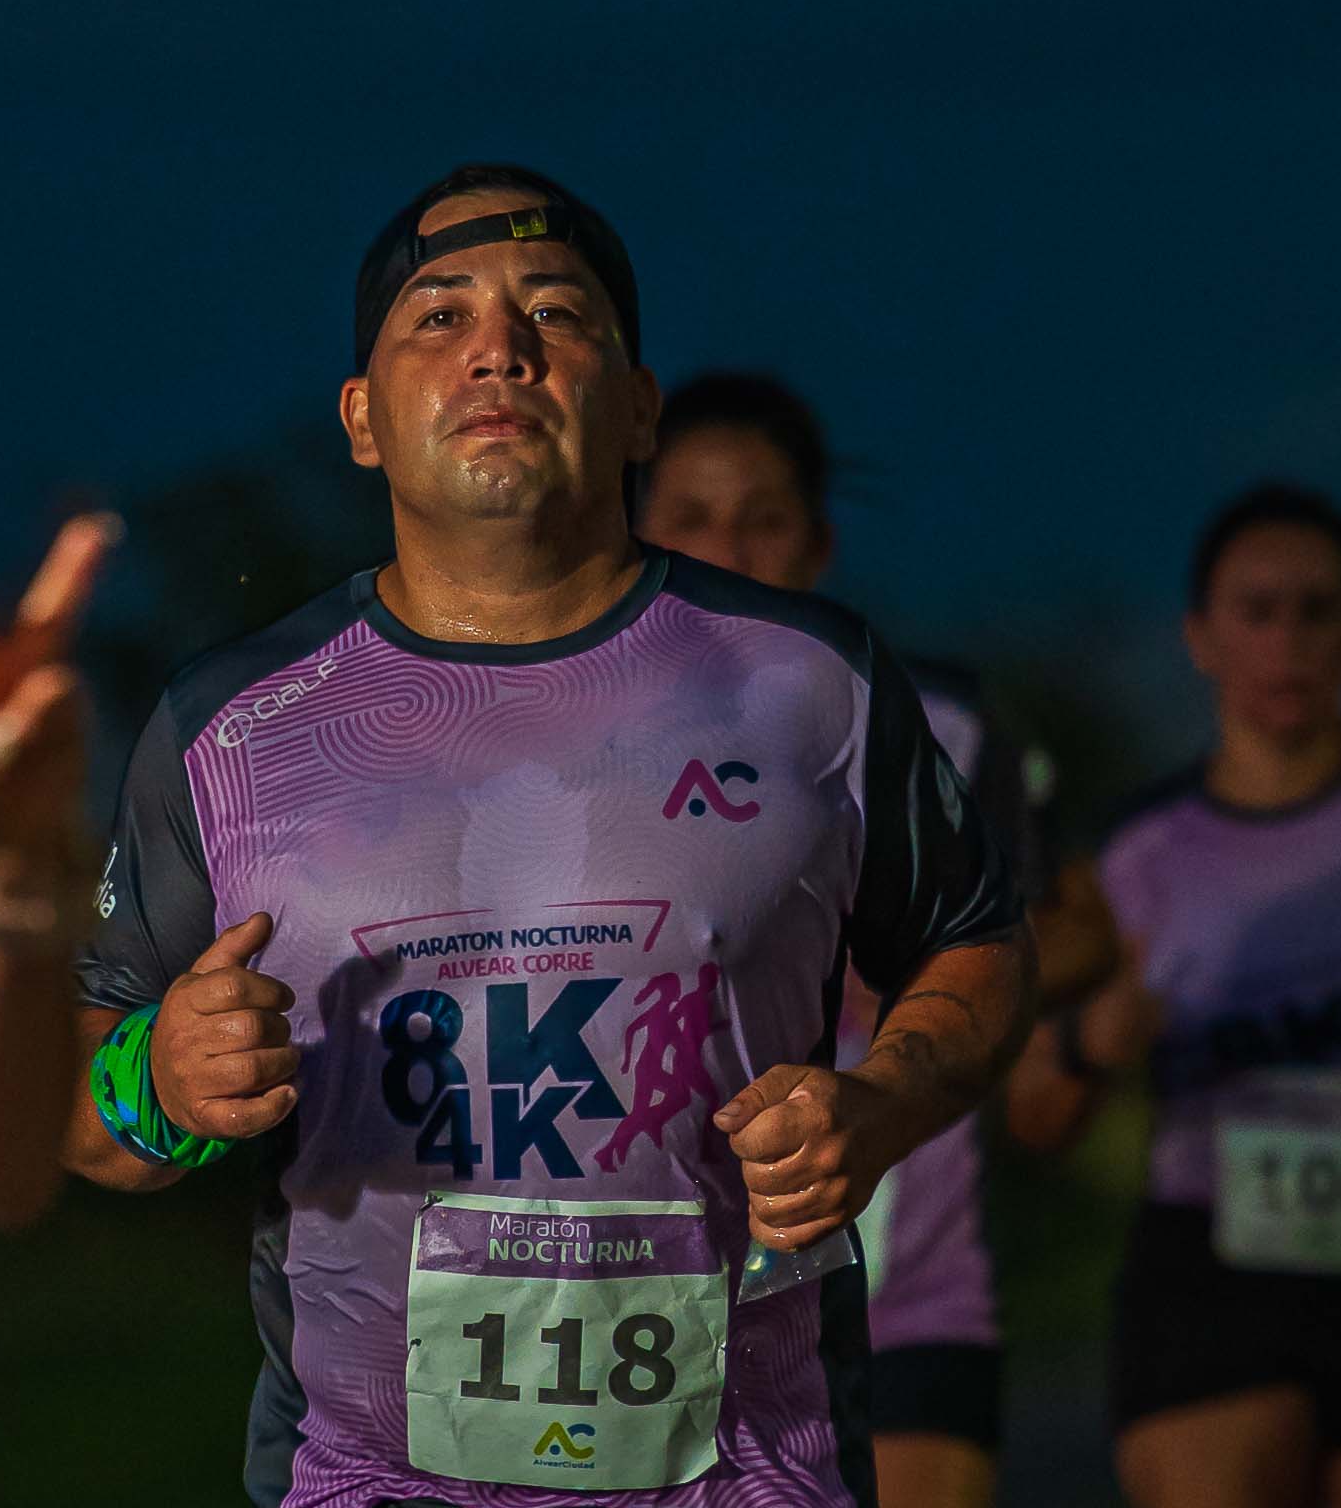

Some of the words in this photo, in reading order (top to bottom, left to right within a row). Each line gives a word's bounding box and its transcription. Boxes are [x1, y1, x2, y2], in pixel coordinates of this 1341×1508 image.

[396, 930, 504, 961] MARATON
[510, 924, 633, 948] NOCTURNA
[437, 955, 516, 981] ALVEAR
[522, 952, 595, 974] CORRE
[378, 977, 629, 1127] 8K
[415, 1086, 587, 1182] 4K
[489, 1213, 591, 1239] Maratón
[488, 1238, 655, 1265] NOCTURNA
[459, 1312, 677, 1407] 118
